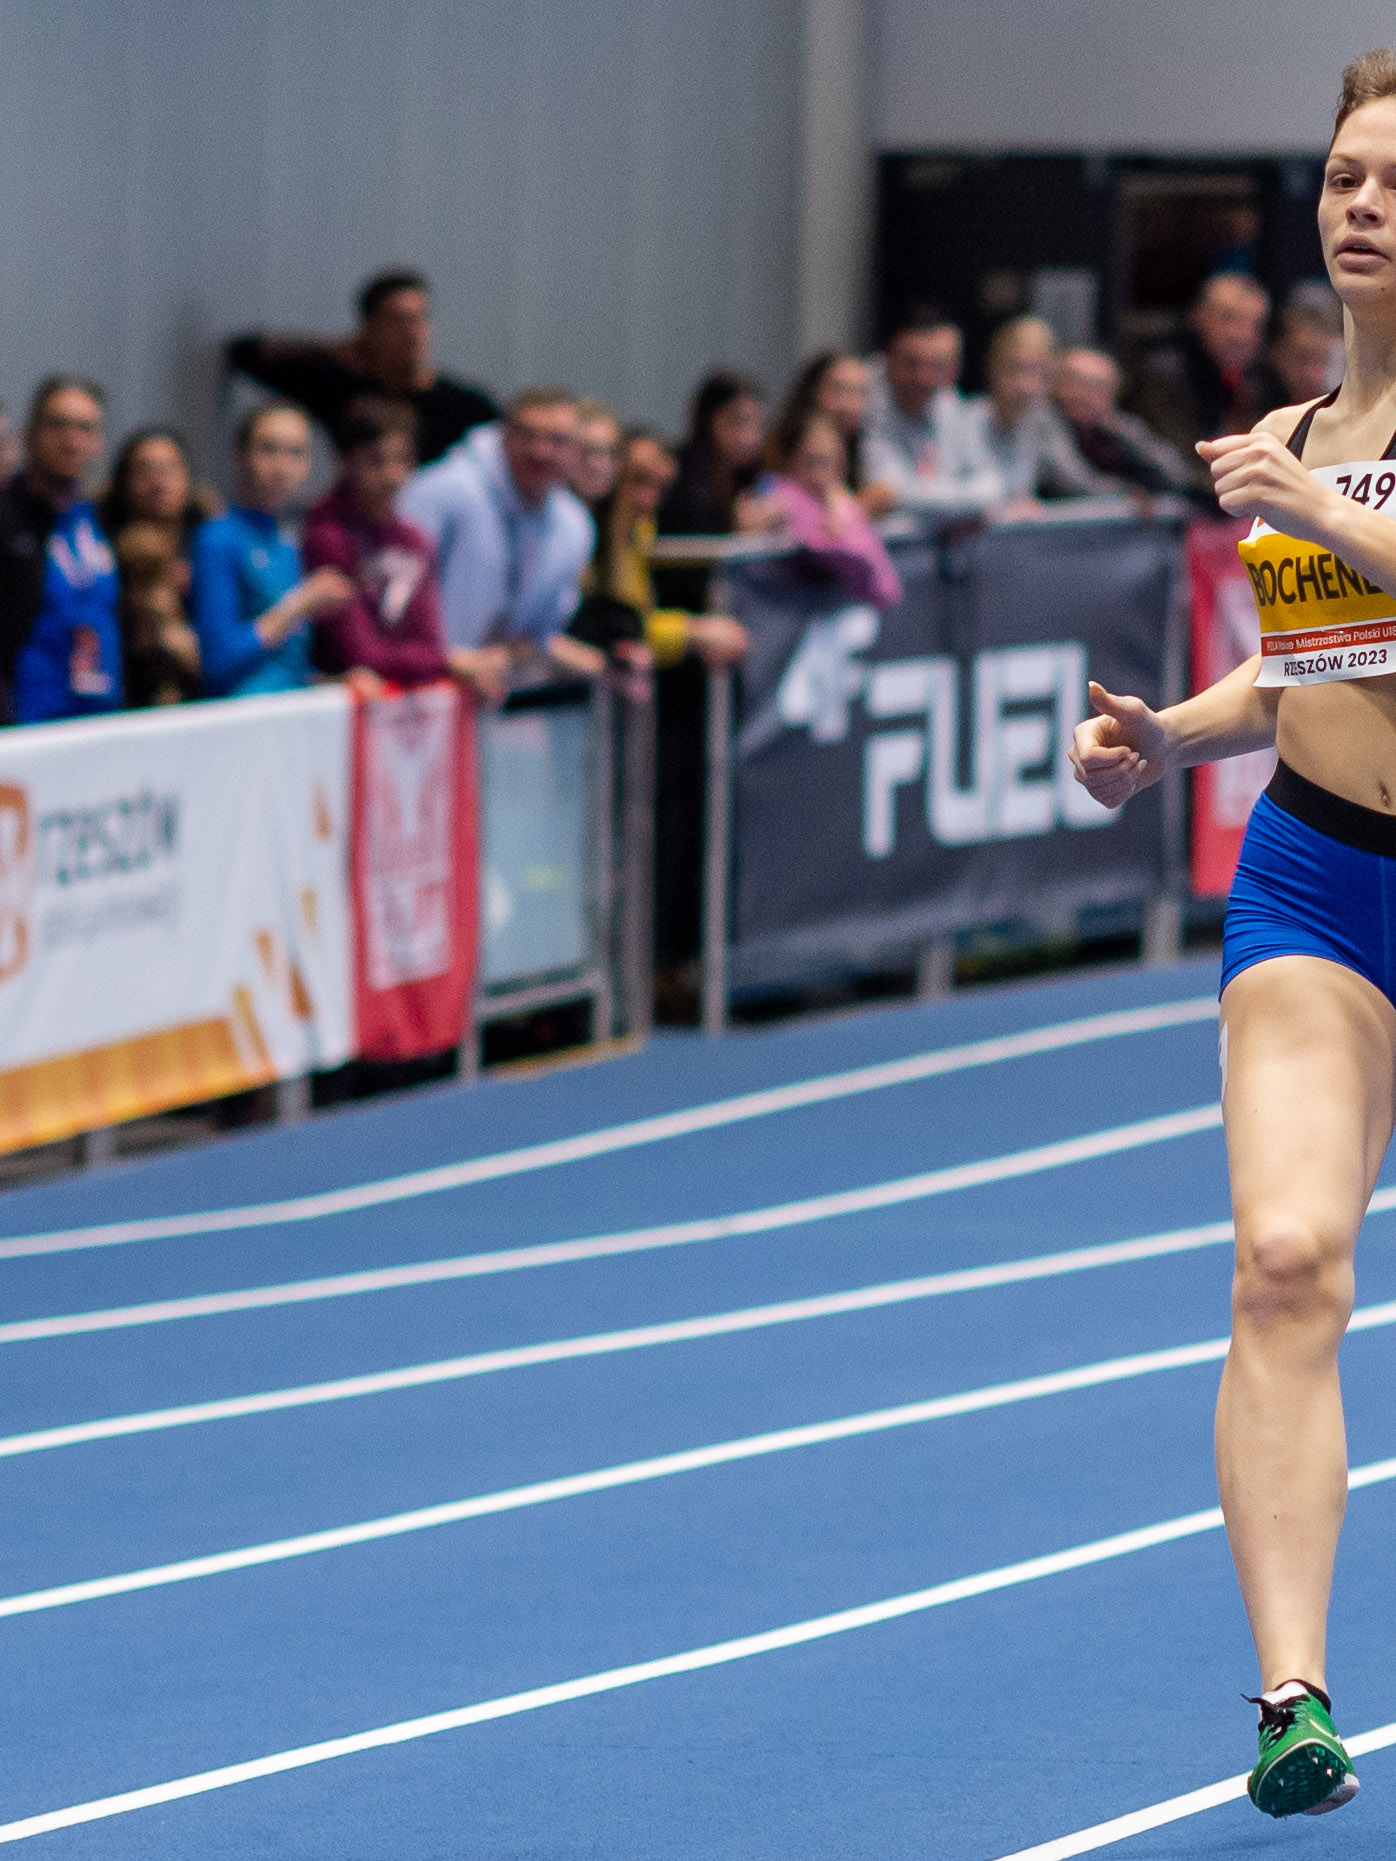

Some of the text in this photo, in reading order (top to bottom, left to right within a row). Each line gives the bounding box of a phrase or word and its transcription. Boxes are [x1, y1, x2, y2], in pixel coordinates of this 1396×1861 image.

[1336, 472, 1396, 510] 749
[1296, 632, 1352, 649] Mistrzostwa
[1353, 627, 1380, 641] Polski
[1347, 648, 1388, 668] 2023
[862, 639, 1124, 860] FUEL
